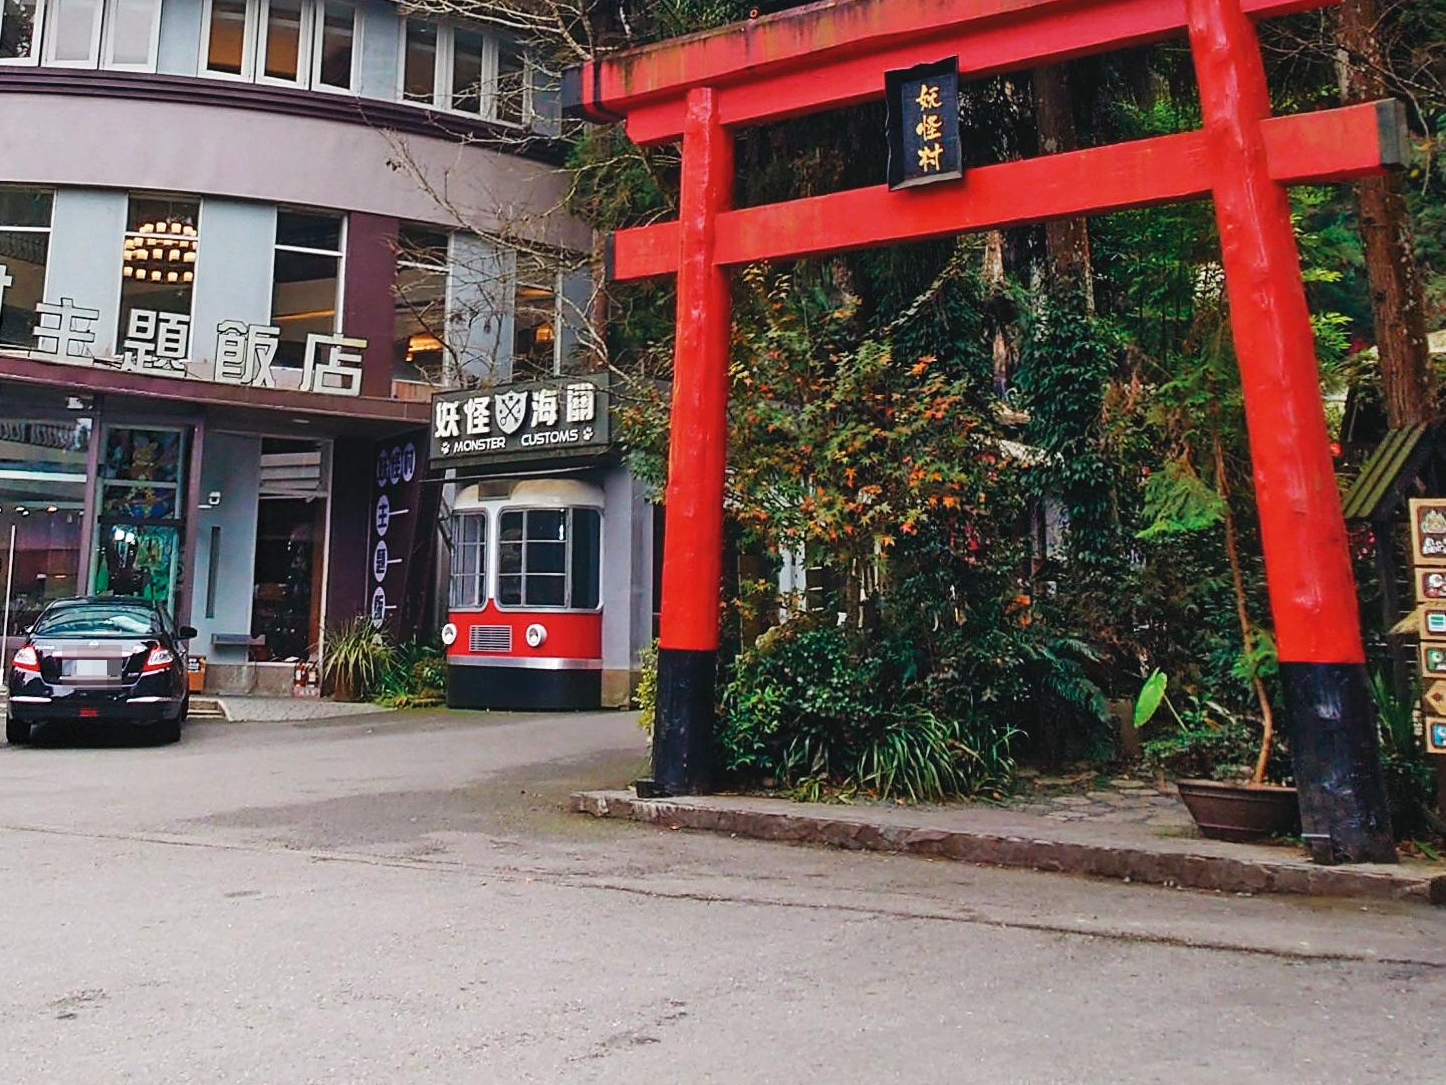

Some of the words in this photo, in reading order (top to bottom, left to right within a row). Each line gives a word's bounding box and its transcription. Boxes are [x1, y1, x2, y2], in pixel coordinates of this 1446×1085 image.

[915, 84, 943, 173] 妖怪村
[435, 396, 491, 438] 妖怪
[453, 436, 506, 453] MONSTER
[520, 428, 579, 447] CUSTOMS
